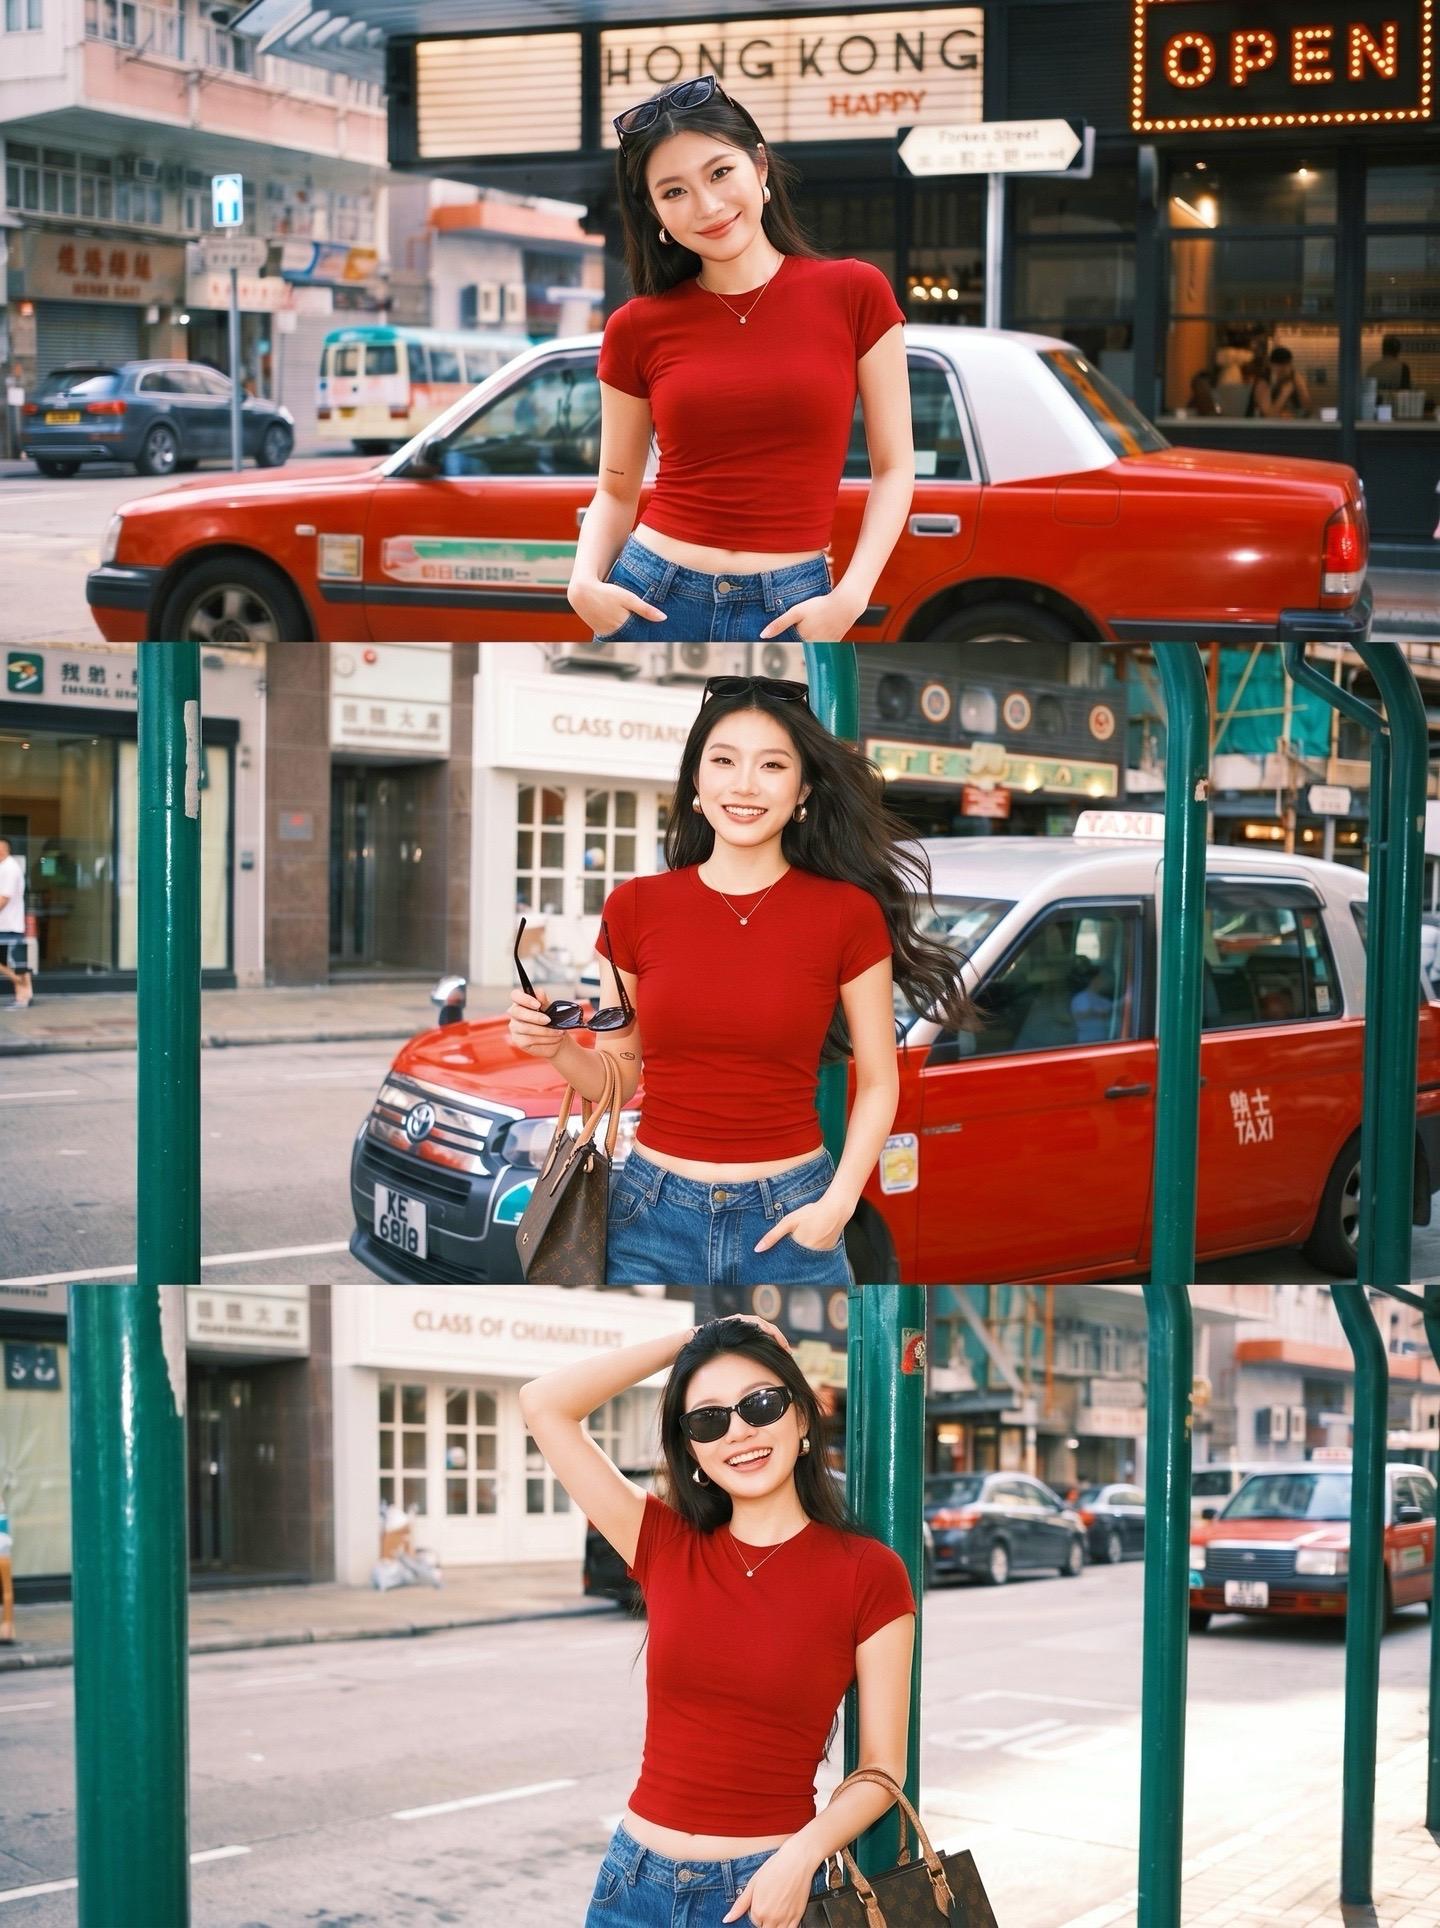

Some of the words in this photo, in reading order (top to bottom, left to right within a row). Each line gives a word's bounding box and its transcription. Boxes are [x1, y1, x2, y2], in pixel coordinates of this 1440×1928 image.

[605, 39, 776, 86] HONG
[799, 29, 979, 78] KONG
[1162, 21, 1399, 88] OPEN
[829, 90, 928, 118] HAPPY
[552, 713, 612, 738] CLASS
[1085, 813, 1154, 835] TAXI
[1233, 1115, 1274, 1145] TAXI
[387, 1190, 409, 1223] KE
[379, 1215, 419, 1254] 6818
[413, 1309, 474, 1337] CLASS
[480, 1315, 504, 1338] OF
